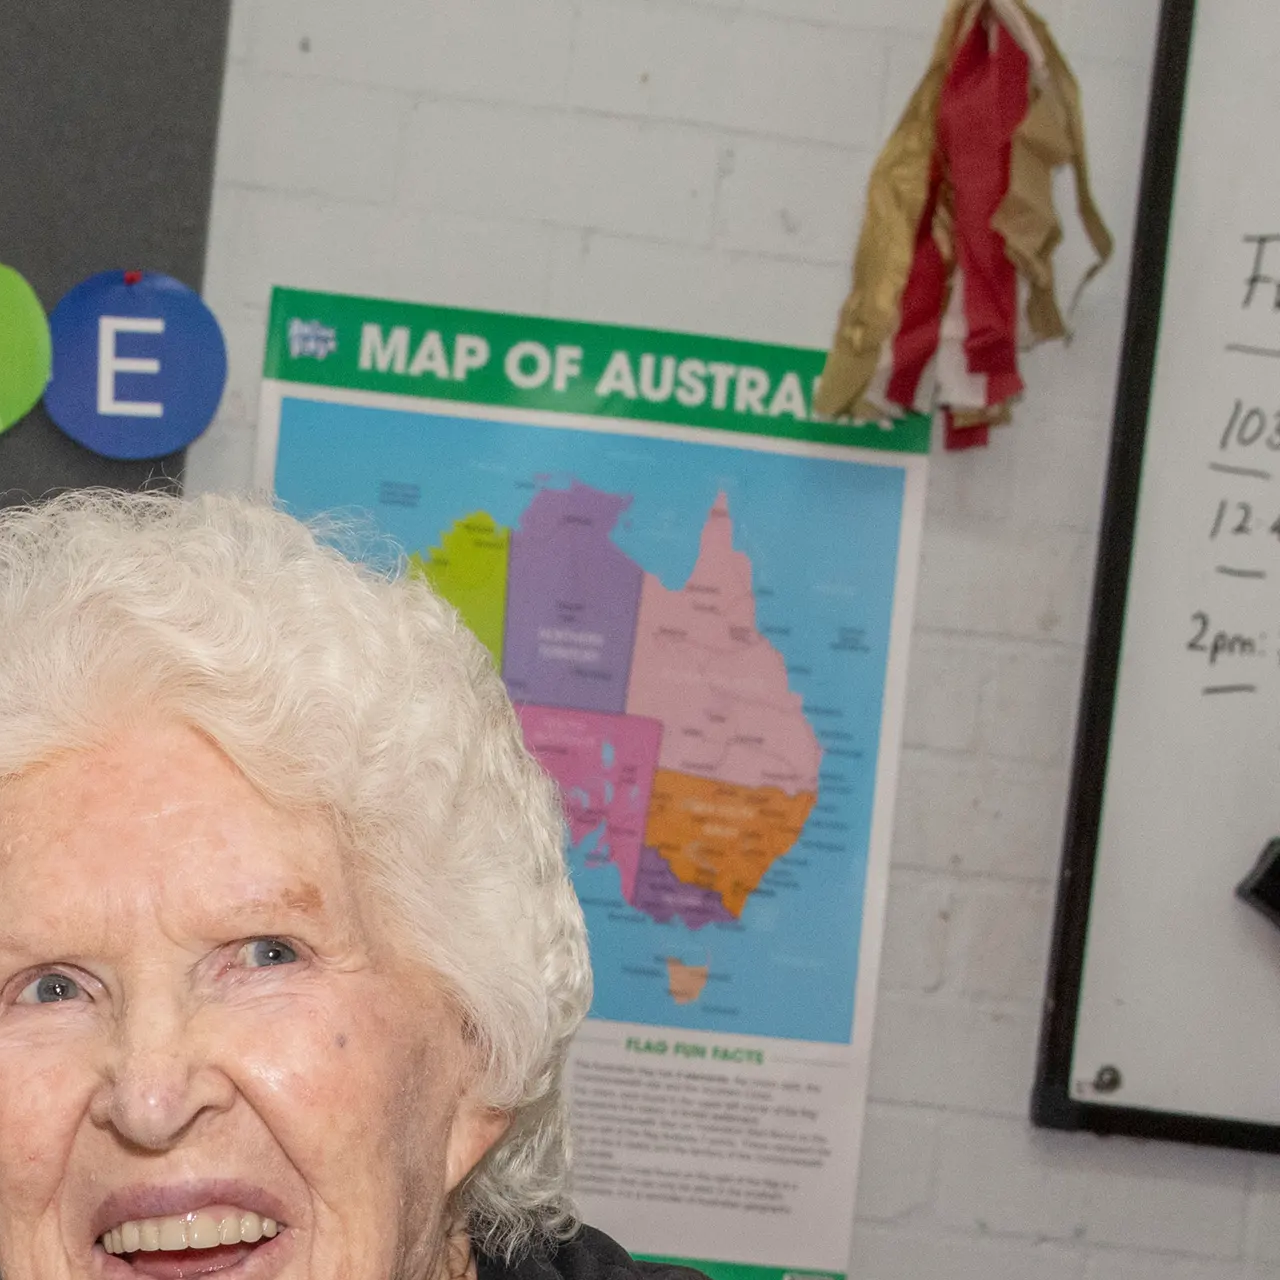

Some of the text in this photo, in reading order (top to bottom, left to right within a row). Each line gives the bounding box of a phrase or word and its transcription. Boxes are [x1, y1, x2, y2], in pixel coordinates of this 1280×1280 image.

[357, 322, 491, 381] MAP
[504, 340, 583, 392] OF
[595, 351, 893, 431] AUSTRA
[625, 1037, 765, 1065] FLAG FUN FACTS
